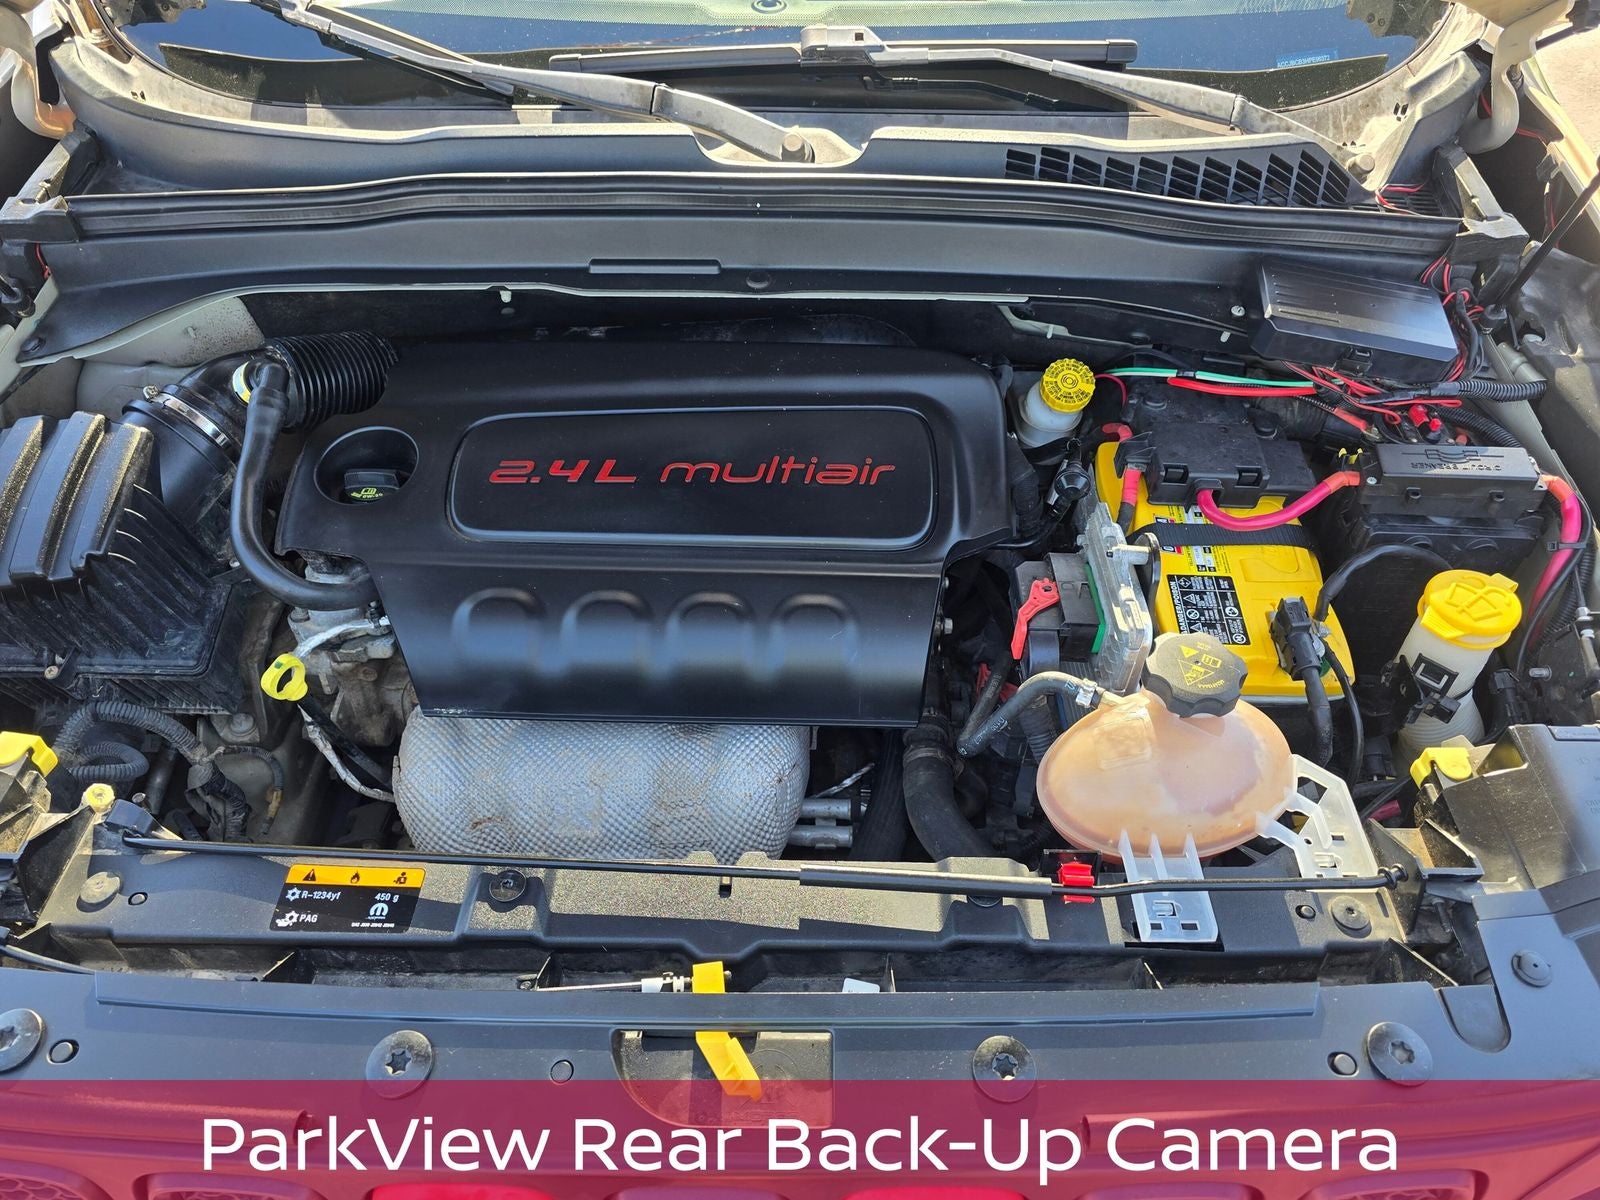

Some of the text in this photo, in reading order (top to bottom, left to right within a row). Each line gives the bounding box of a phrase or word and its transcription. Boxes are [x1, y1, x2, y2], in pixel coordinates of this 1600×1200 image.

[488, 455, 896, 485] 2.4L multiair
[301, 890, 400, 903] R-1234yf 450 g
[298, 913, 319, 923] PAG
